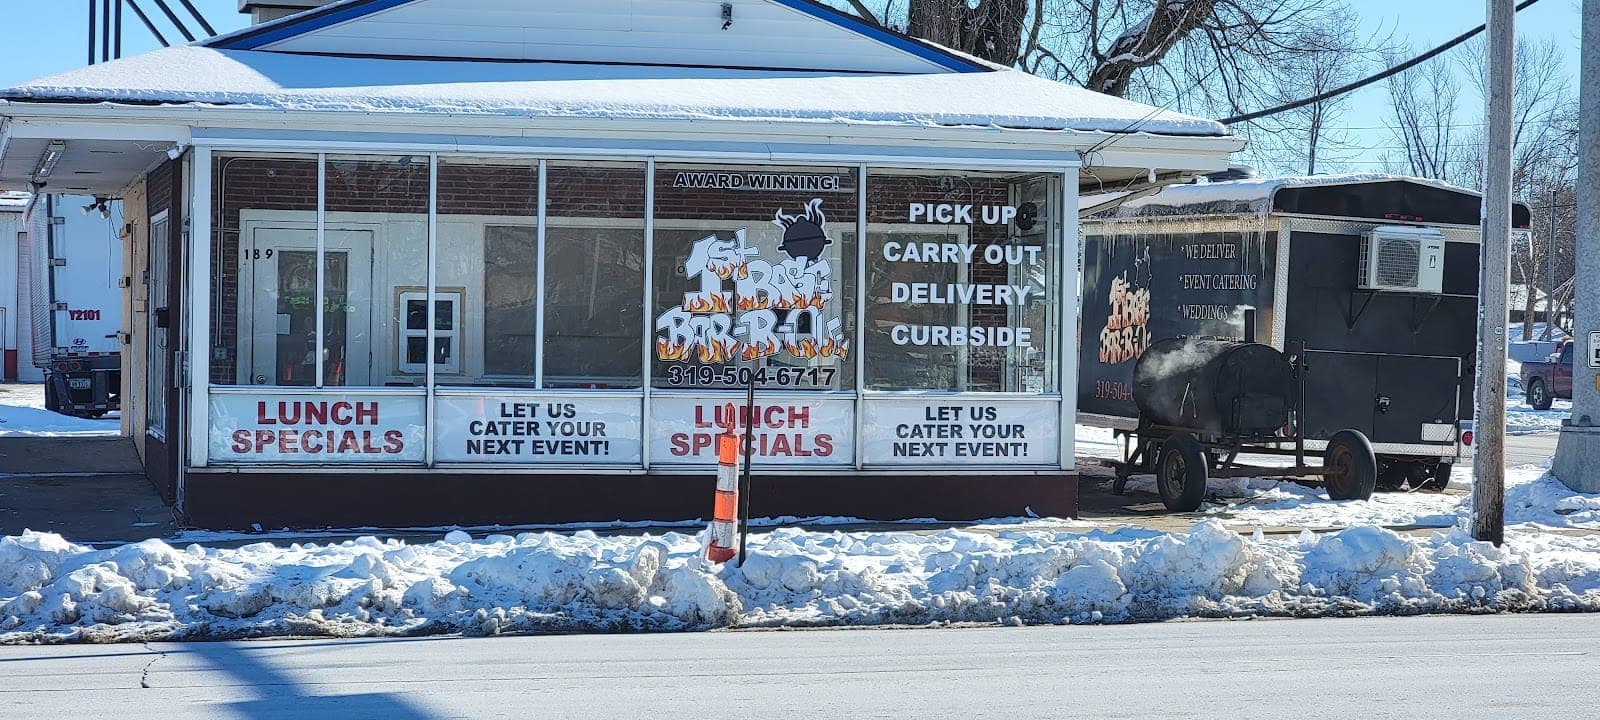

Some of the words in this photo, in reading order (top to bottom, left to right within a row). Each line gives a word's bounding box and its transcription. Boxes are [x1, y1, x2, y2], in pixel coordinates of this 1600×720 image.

[673, 173, 743, 188] AWARD
[750, 175, 839, 190] WINNING!
[909, 202, 973, 224] PICK
[981, 205, 1017, 224] UP
[244, 248, 273, 260] 189
[883, 241, 978, 264] CARRY
[984, 244, 1042, 266] OUT
[1185, 244, 1199, 259] WE
[1200, 244, 1236, 259] DELIVER
[1184, 275, 1211, 289] EVENT
[1212, 275, 1257, 290] CATERING
[891, 282, 1031, 305] DELIVERY
[69, 309, 100, 321] Y2101
[1183, 304, 1229, 320] WEDDINGS
[890, 324, 1032, 347] CURBSIDE
[667, 365, 836, 387] 319-504-6717
[257, 401, 379, 425] LUNCH
[500, 402, 540, 418] LET
[547, 403, 576, 418] US
[694, 405, 810, 429] LUNCH
[925, 406, 963, 421] LET
[970, 406, 997, 421] US
[469, 420, 540, 436] CATER
[546, 421, 606, 437] YOUR
[895, 423, 963, 439] CATER
[968, 424, 1025, 439] YOUR
[231, 429, 404, 454] SPECIALS
[466, 440, 524, 455] NEXT
[531, 440, 609, 455] EVENT!
[893, 442, 948, 457] NEXT
[955, 442, 1028, 457] EVENT!
